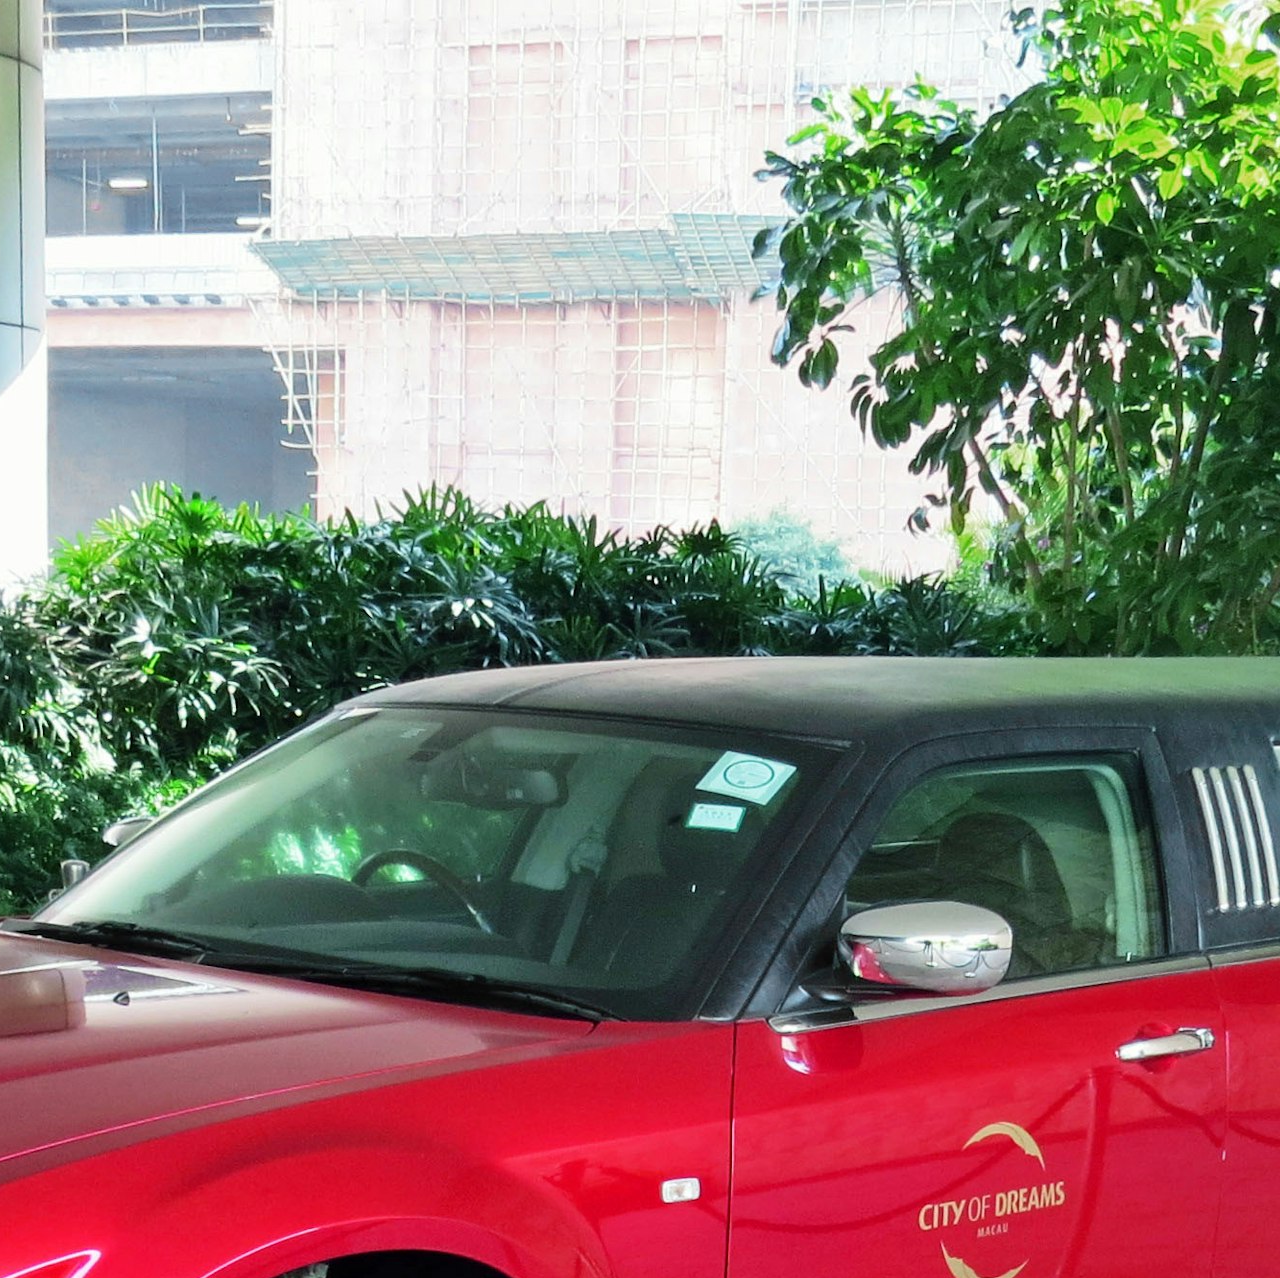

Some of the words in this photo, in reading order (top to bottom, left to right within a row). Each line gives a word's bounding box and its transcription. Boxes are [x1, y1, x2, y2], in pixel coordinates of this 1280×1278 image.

[918, 1199, 966, 1231] CITY
[968, 1195, 992, 1222] OF
[995, 1181, 1066, 1217] DREAMS
[976, 1223, 1009, 1238] MACAU
